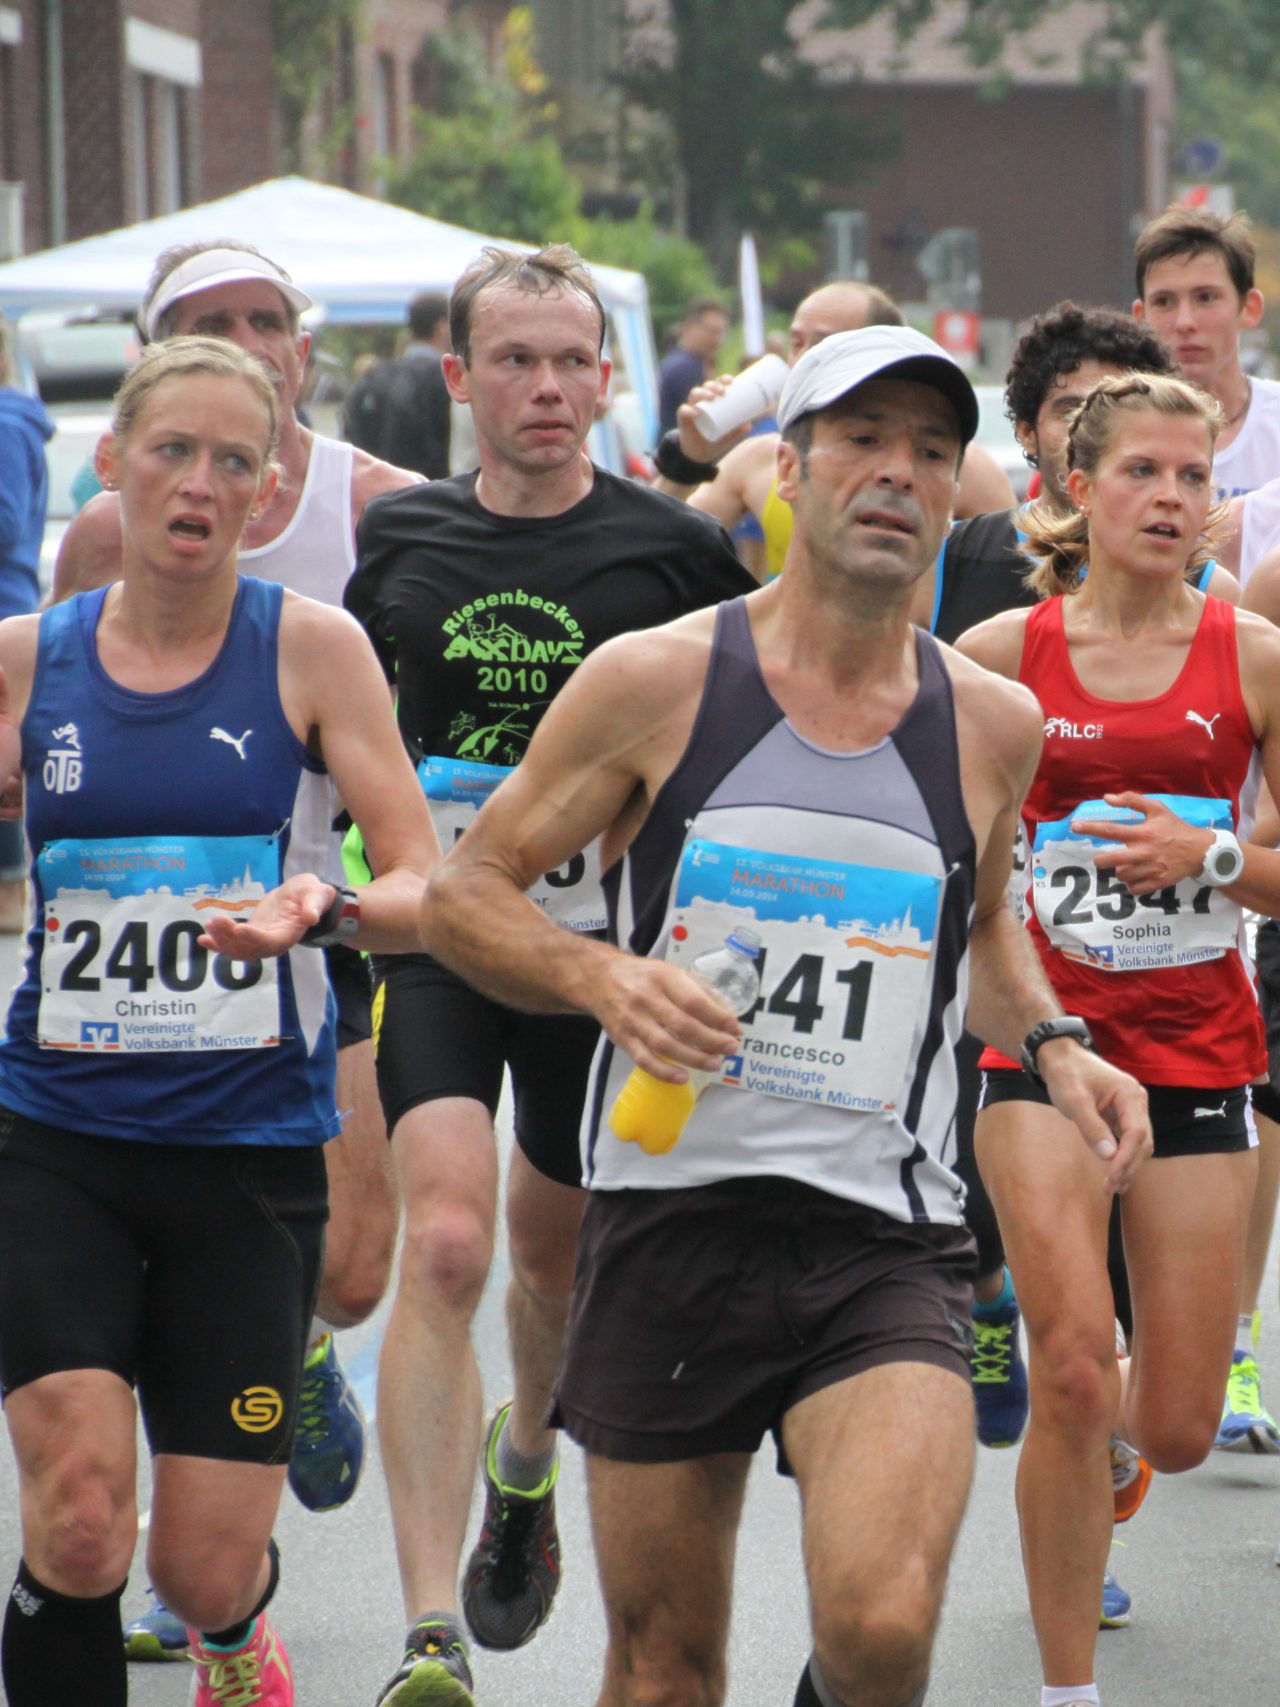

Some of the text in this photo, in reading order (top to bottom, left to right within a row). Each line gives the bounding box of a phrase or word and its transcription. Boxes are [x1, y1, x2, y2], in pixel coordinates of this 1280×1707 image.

[441, 588, 585, 641] Riesenbecker
[476, 666, 548, 694] 2010
[1060, 722, 1097, 739] RLC
[42, 749, 83, 795] OTB
[82, 855, 187, 872] MARATHON
[732, 868, 846, 901] MARATHON
[1112, 923, 1172, 942] Sophia
[1117, 943, 1174, 955] Vereinigte
[1118, 948, 1220, 969] Volksbank Münster
[115, 1001, 196, 1017] Christin
[124, 1022, 196, 1035] Vereinigte
[124, 1034, 258, 1051] Volksbank Münster
[737, 1036, 846, 1067] rancesco
[749, 1060, 826, 1084] Vereinigte
[746, 1076, 883, 1110] Volksbank Münster
